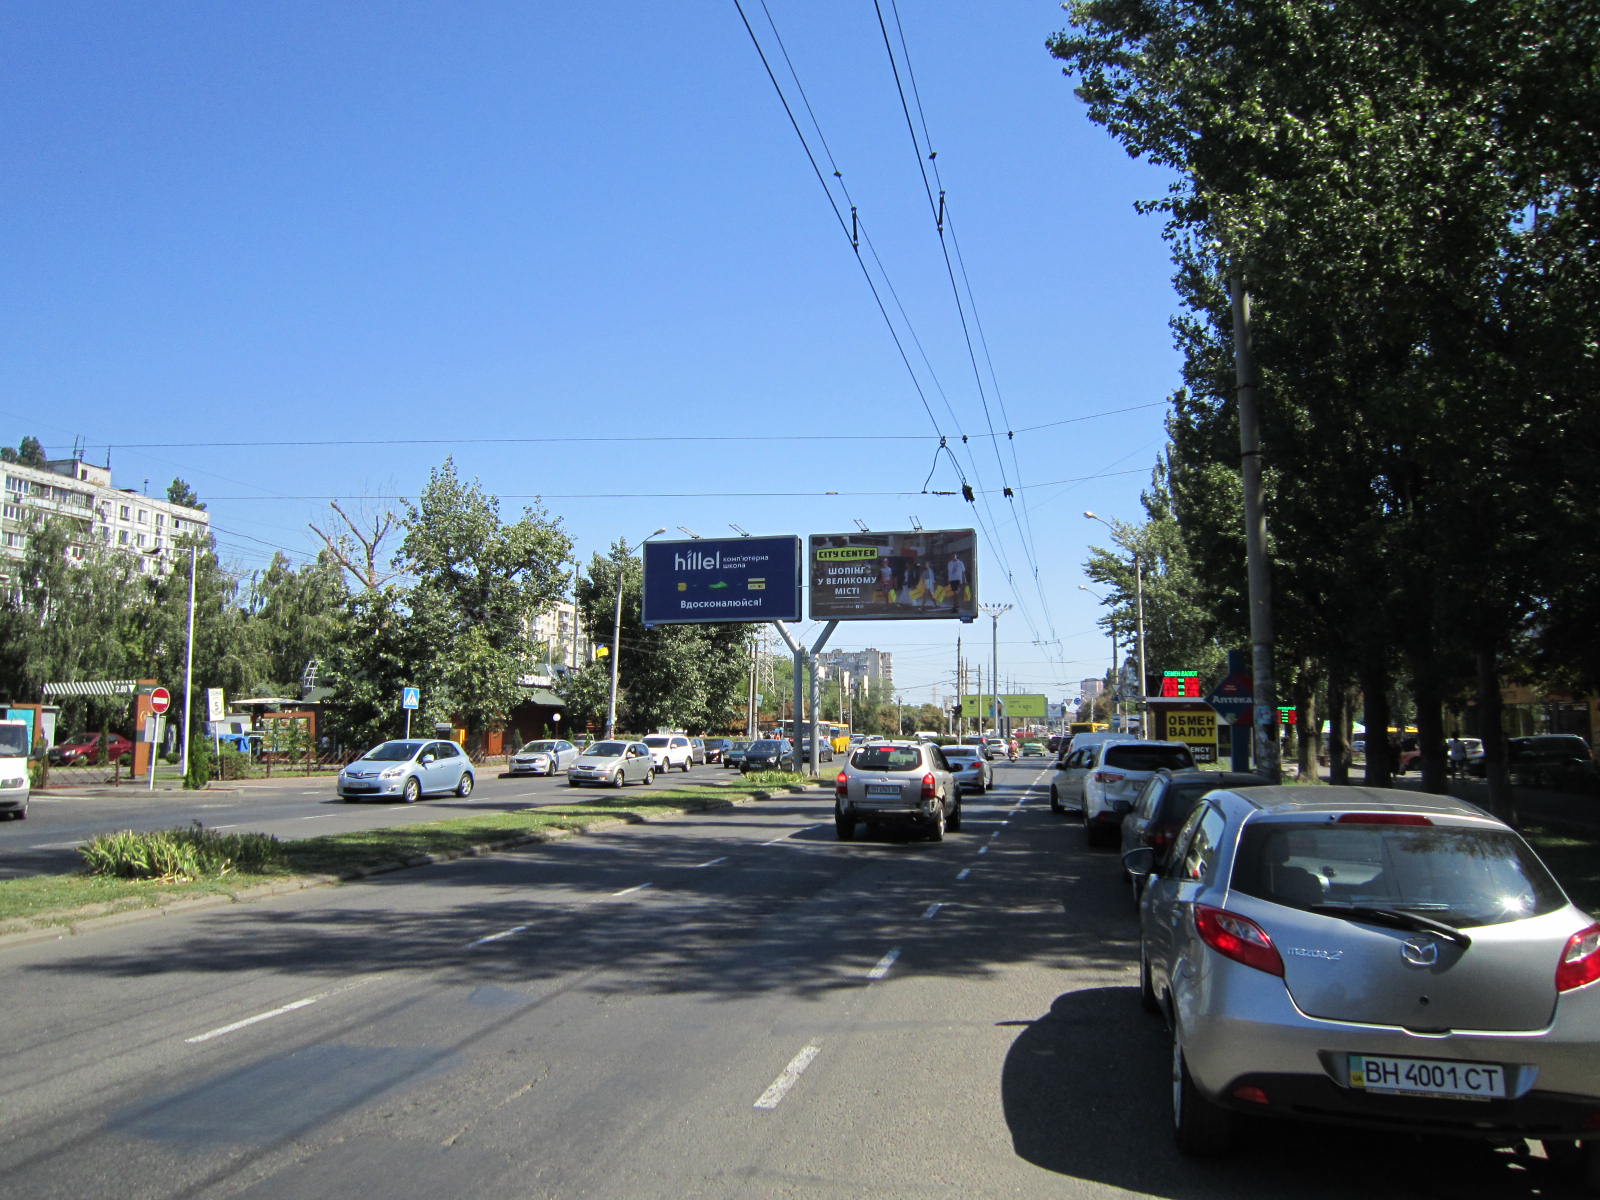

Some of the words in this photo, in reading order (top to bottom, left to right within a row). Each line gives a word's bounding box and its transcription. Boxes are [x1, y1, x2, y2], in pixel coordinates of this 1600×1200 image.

[818, 551, 839, 559] CITY
[841, 549, 876, 558] CENTER
[674, 550, 720, 571] hillel
[828, 566, 866, 575] ШОПІНГ
[817, 578, 825, 586] У
[826, 576, 877, 585] ВЕЛИКОМУ
[834, 587, 860, 595] МІСТІ
[680, 597, 762, 610] Вдосконалюйся!
[1212, 695, 1253, 704] Аптека
[1168, 715, 1214, 726] ОБМЕН
[1168, 727, 1215, 737] ВАЛЮТ
[1365, 1060, 1400, 1085] BH
[1405, 1063, 1458, 1089] 4001
[1465, 1068, 1499, 1092] CT
